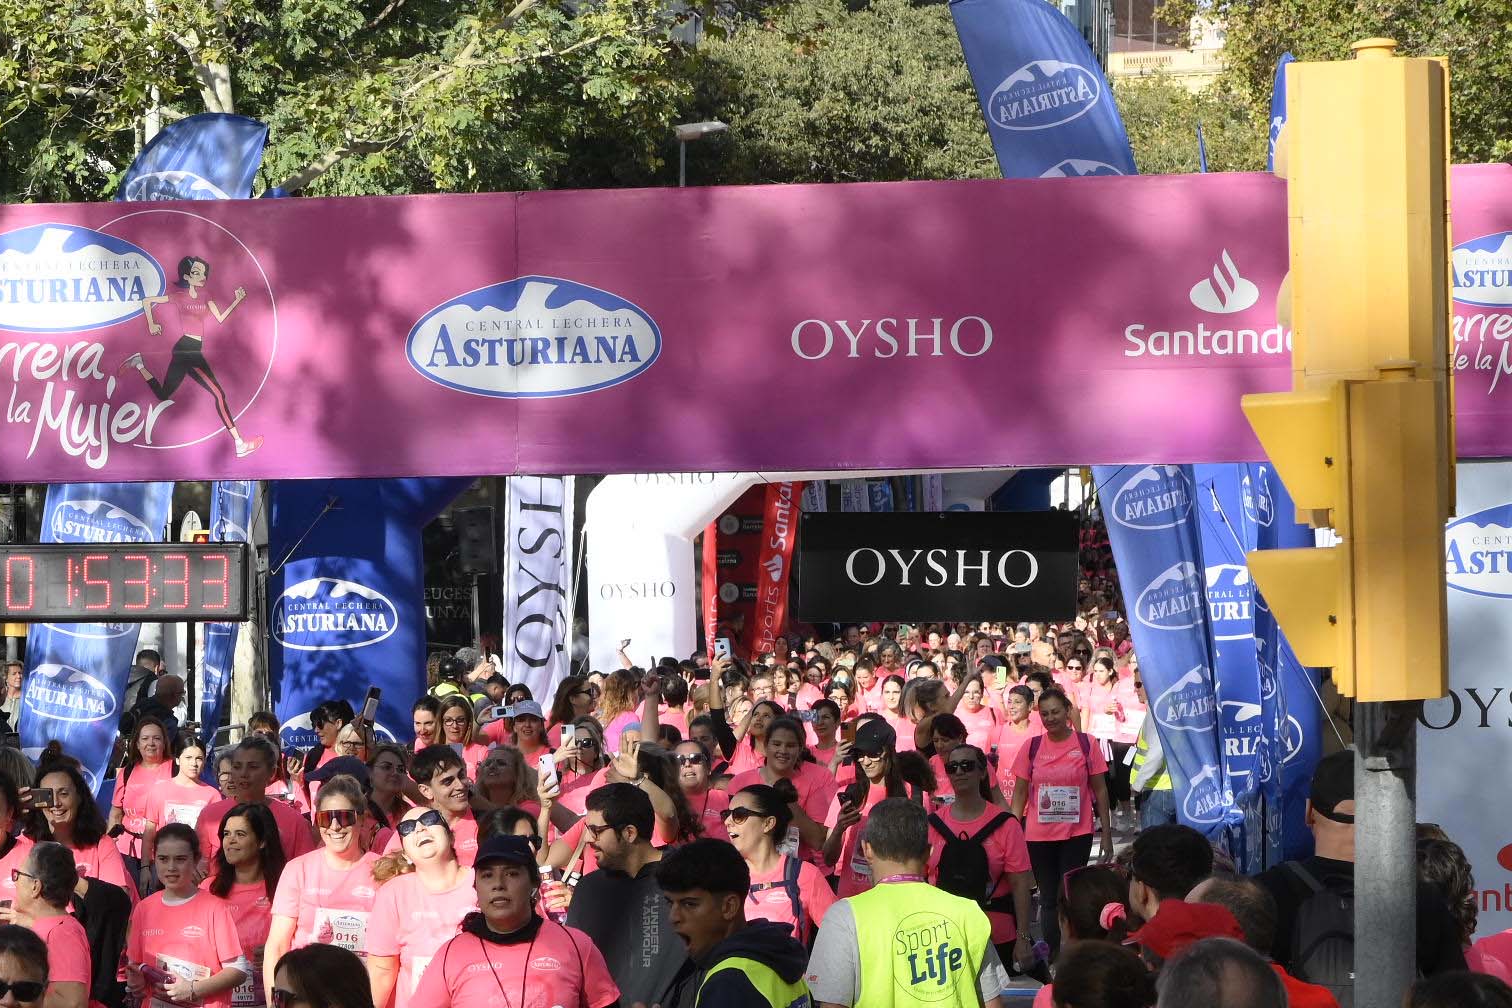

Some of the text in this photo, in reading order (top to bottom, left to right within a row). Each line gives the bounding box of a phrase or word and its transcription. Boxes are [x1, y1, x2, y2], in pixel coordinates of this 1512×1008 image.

[465, 317, 633, 332] CENTRAL LECHERA
[790, 315, 993, 360] OYSHO
[426, 323, 641, 367] ASTURIANA
[1474, 343, 1493, 370] la
[6, 384, 31, 424] la
[26, 376, 175, 470] Mujer
[6, 555, 229, 609] 01:53:33
[845, 546, 1039, 589] OYSHO
[288, 601, 384, 611] CENTRAL LECHERA
[600, 581, 676, 600] OYSHO
[276, 607, 389, 634] ASTURIANA
[336, 933, 358, 943] 016
[642, 906, 651, 967] ARMOUR
[650, 905, 659, 954] UNDER
[896, 919, 952, 956] Sport
[908, 942, 963, 986] Life
[235, 985, 254, 993] 016
